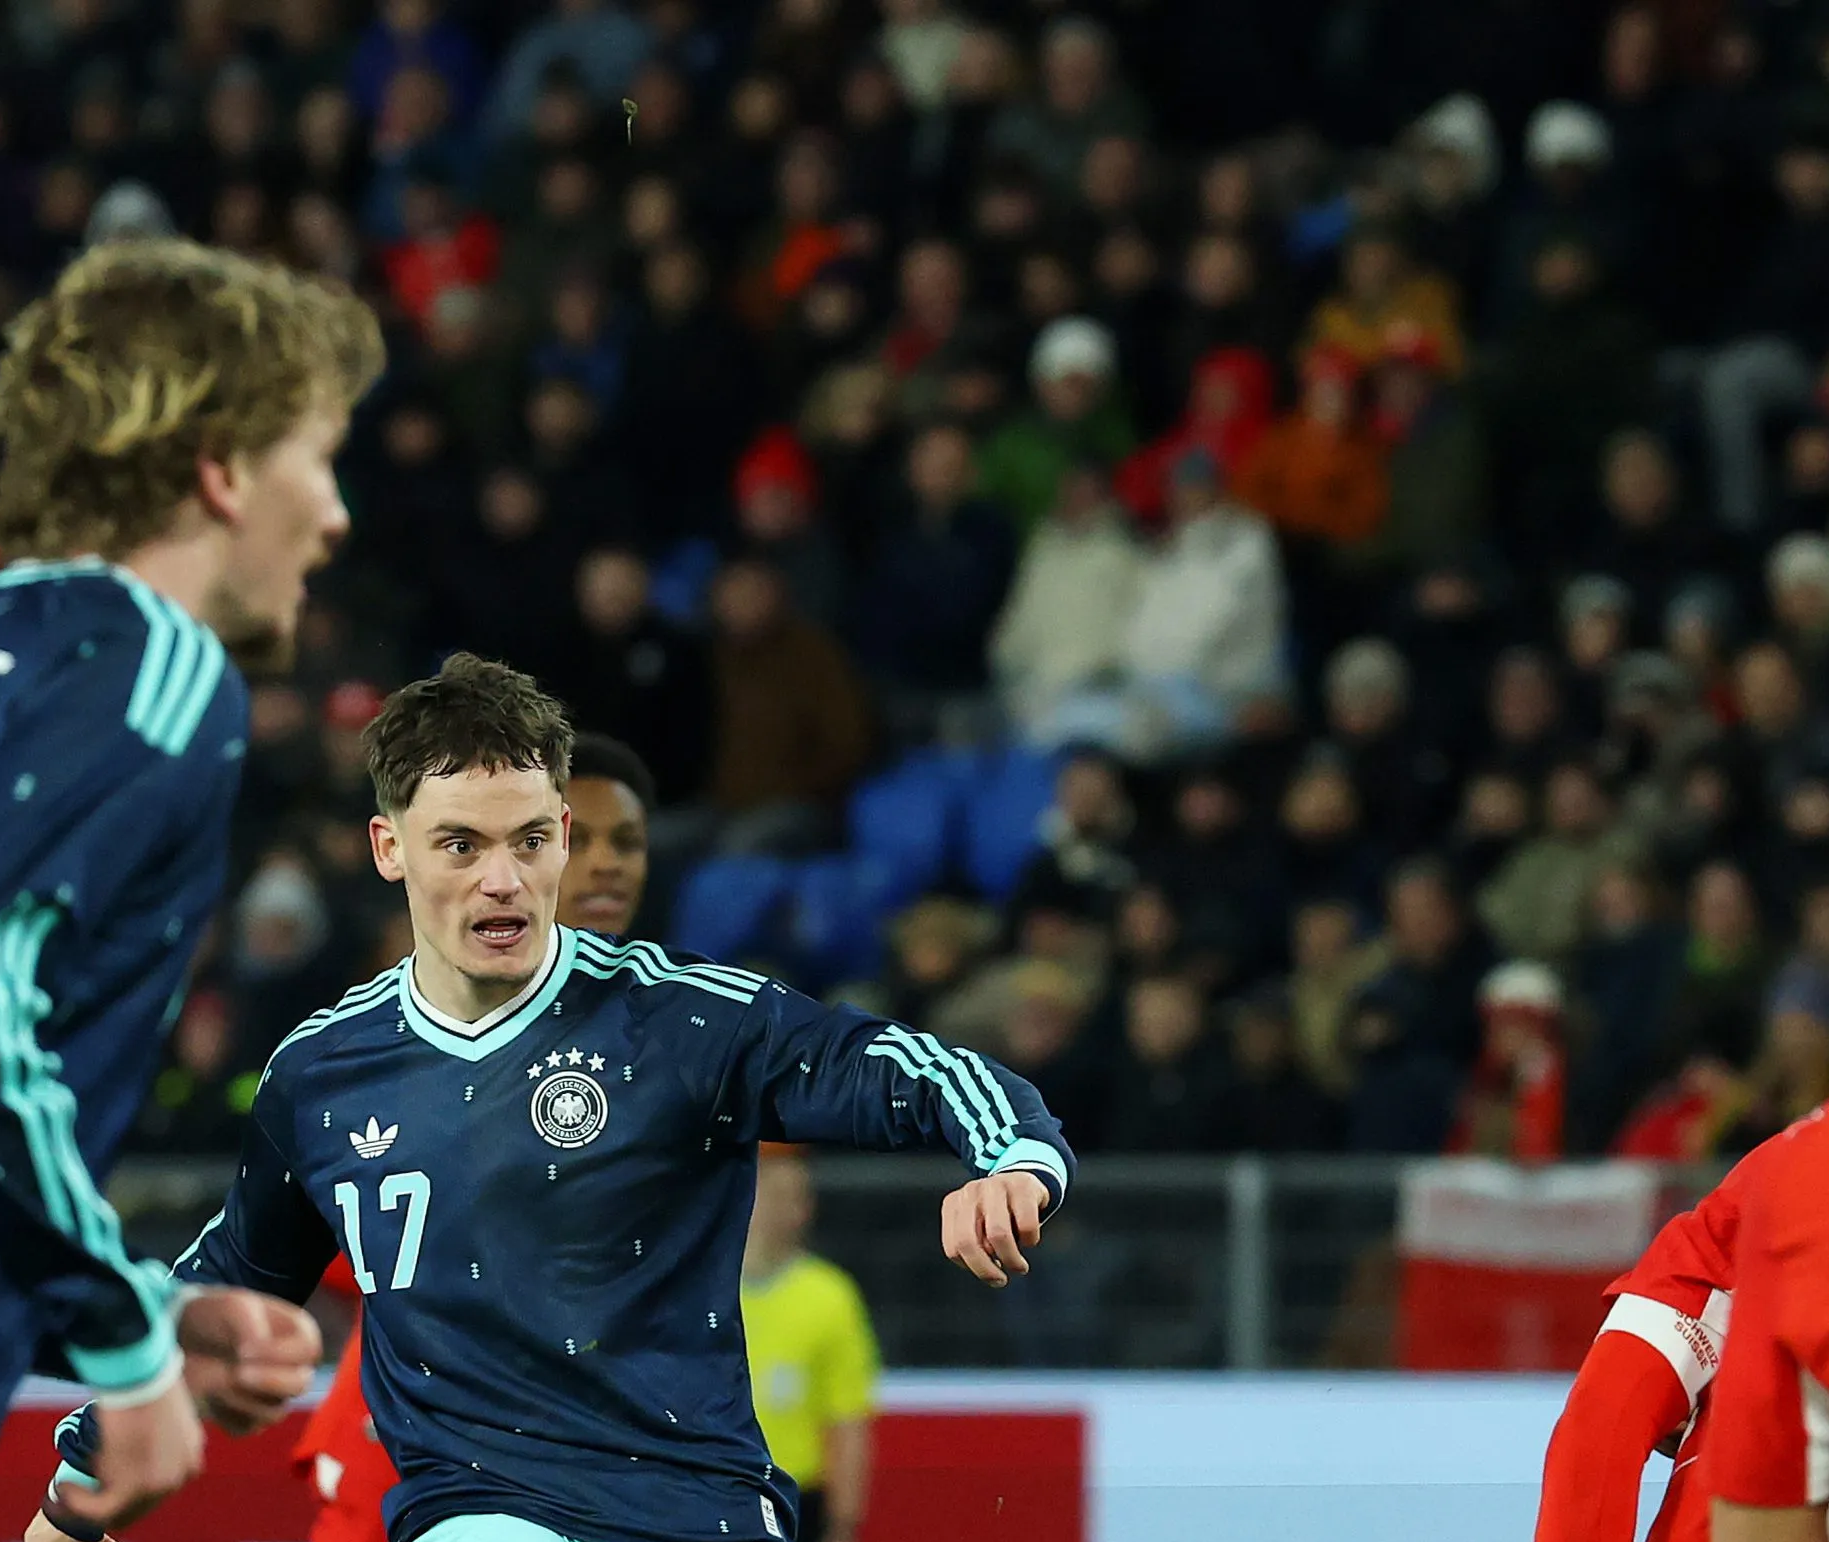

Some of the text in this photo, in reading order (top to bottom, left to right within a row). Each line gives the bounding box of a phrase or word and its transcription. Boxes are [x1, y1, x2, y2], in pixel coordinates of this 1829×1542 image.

[545, 1081, 590, 1098] DEUTSCHER
[335, 1171, 431, 1294] 17
[1674, 1321, 1708, 1371] SUISSE
